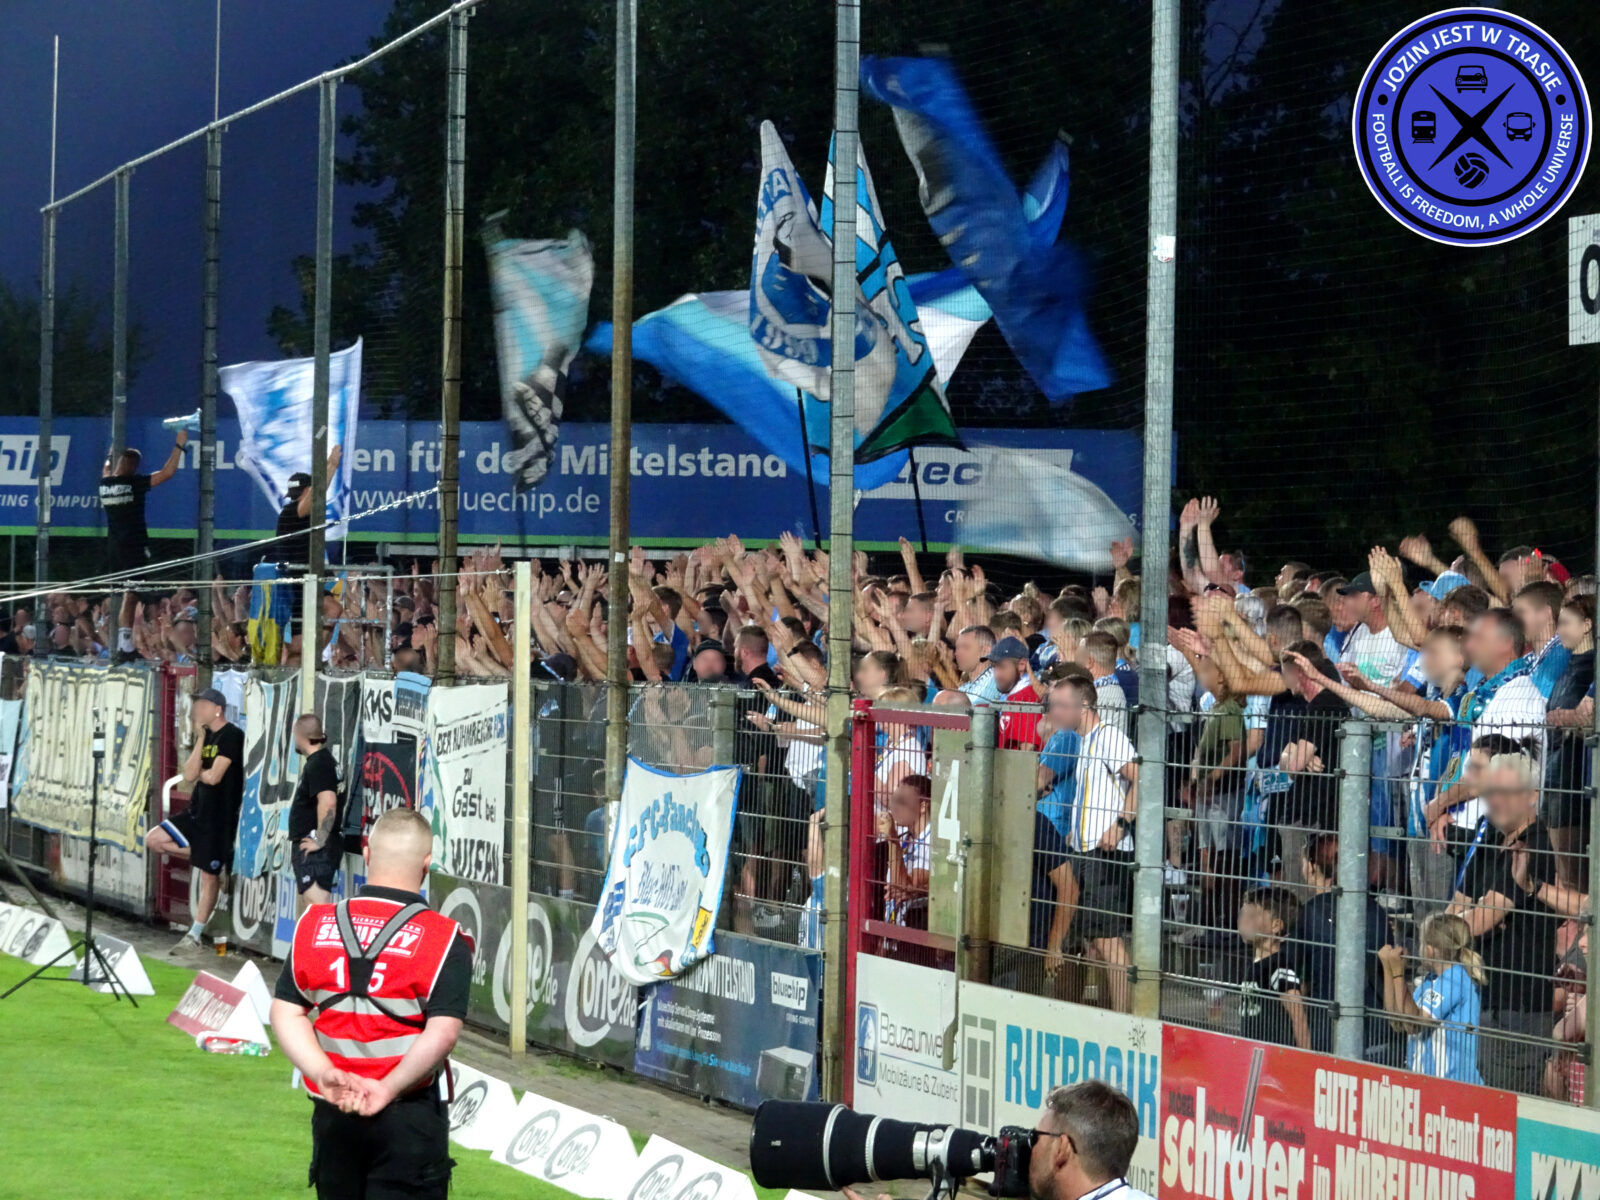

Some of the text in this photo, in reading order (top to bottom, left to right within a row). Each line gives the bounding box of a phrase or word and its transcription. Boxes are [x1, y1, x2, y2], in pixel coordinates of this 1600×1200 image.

[561, 443, 787, 478] Mitelstand
[353, 486, 601, 519] www.luechip.de
[364, 688, 393, 727] KMS
[452, 785, 496, 823] Gast bei
[938, 759, 961, 856] 4
[316, 923, 419, 949] SEURTY
[880, 1011, 959, 1063] Bauzaunwe
[923, 1073, 930, 1094] &
[1314, 1068, 1514, 1173] GUTE MÖBEL erkennt man
[1312, 1154, 1331, 1200] im
